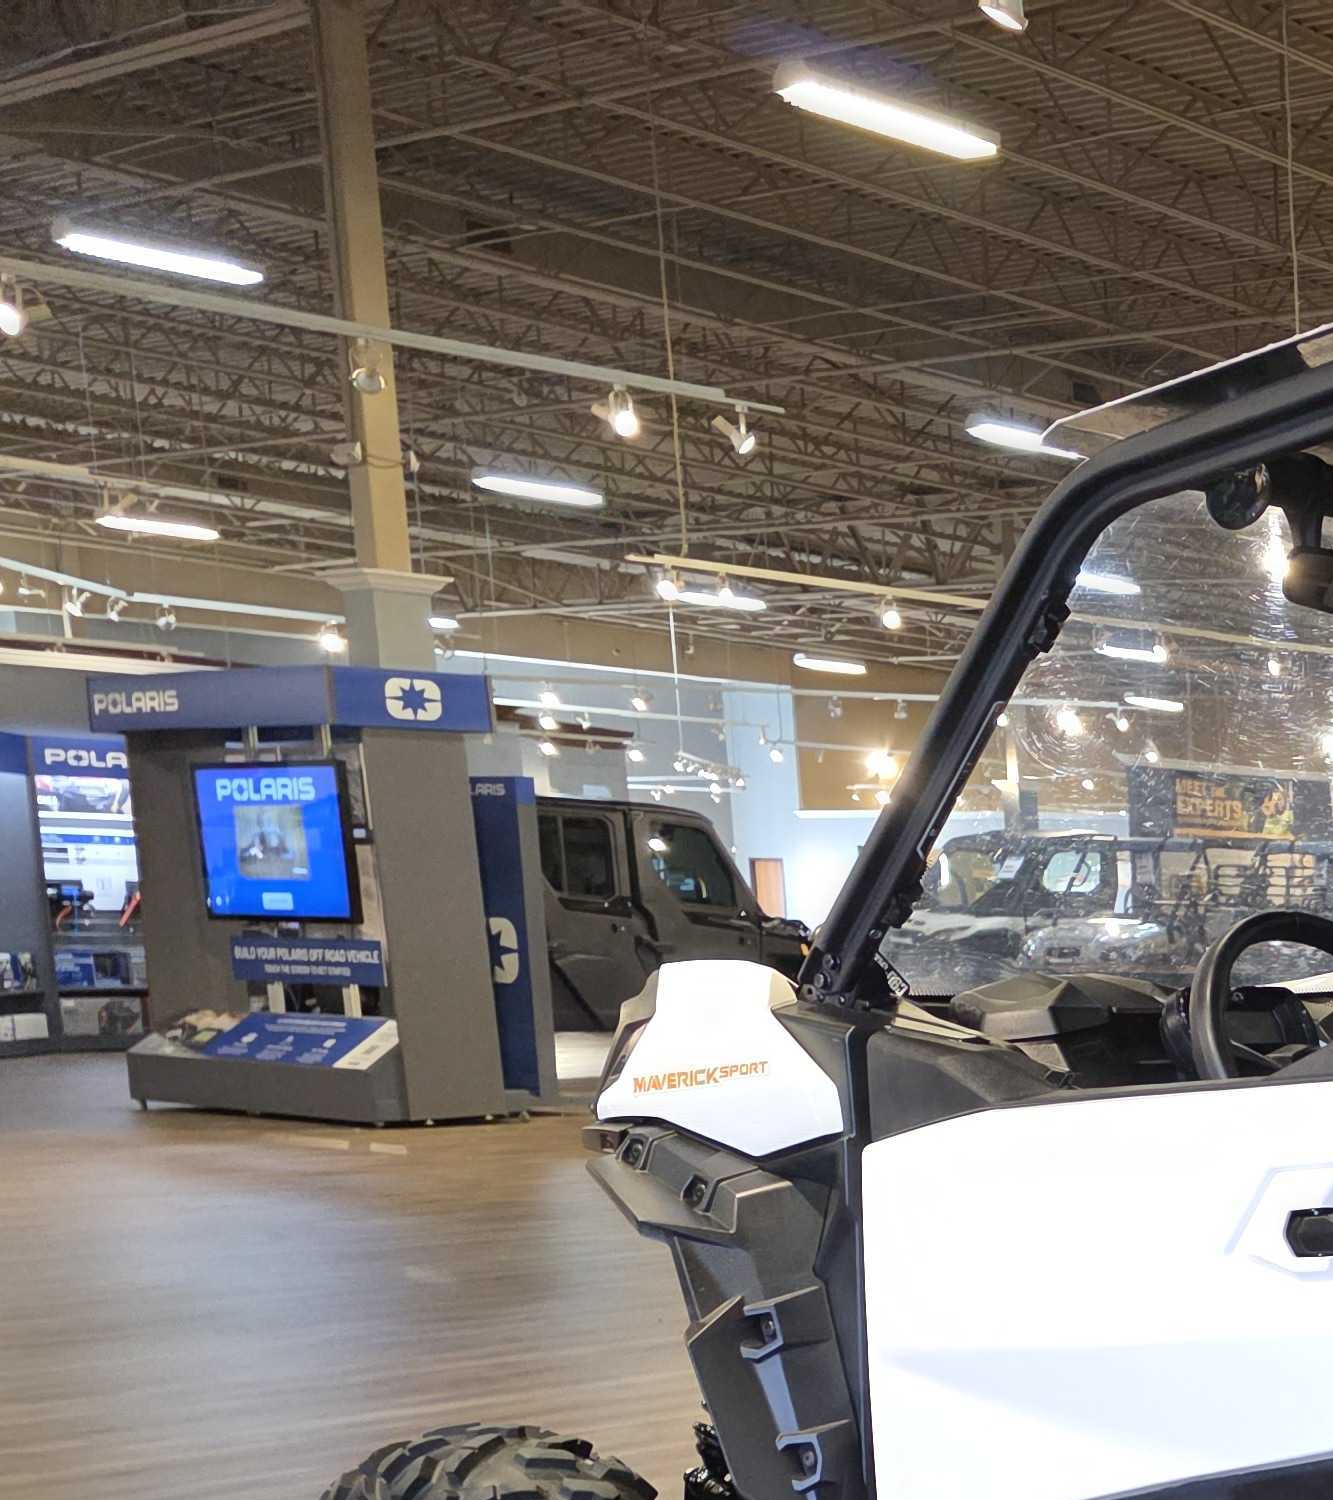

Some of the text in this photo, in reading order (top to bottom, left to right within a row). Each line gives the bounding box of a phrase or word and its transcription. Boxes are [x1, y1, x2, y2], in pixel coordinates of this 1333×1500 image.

[93, 690, 179, 716] POLARIS
[216, 777, 315, 801] POLARIS
[633, 1061, 768, 1094] MAVERICK SPORT
